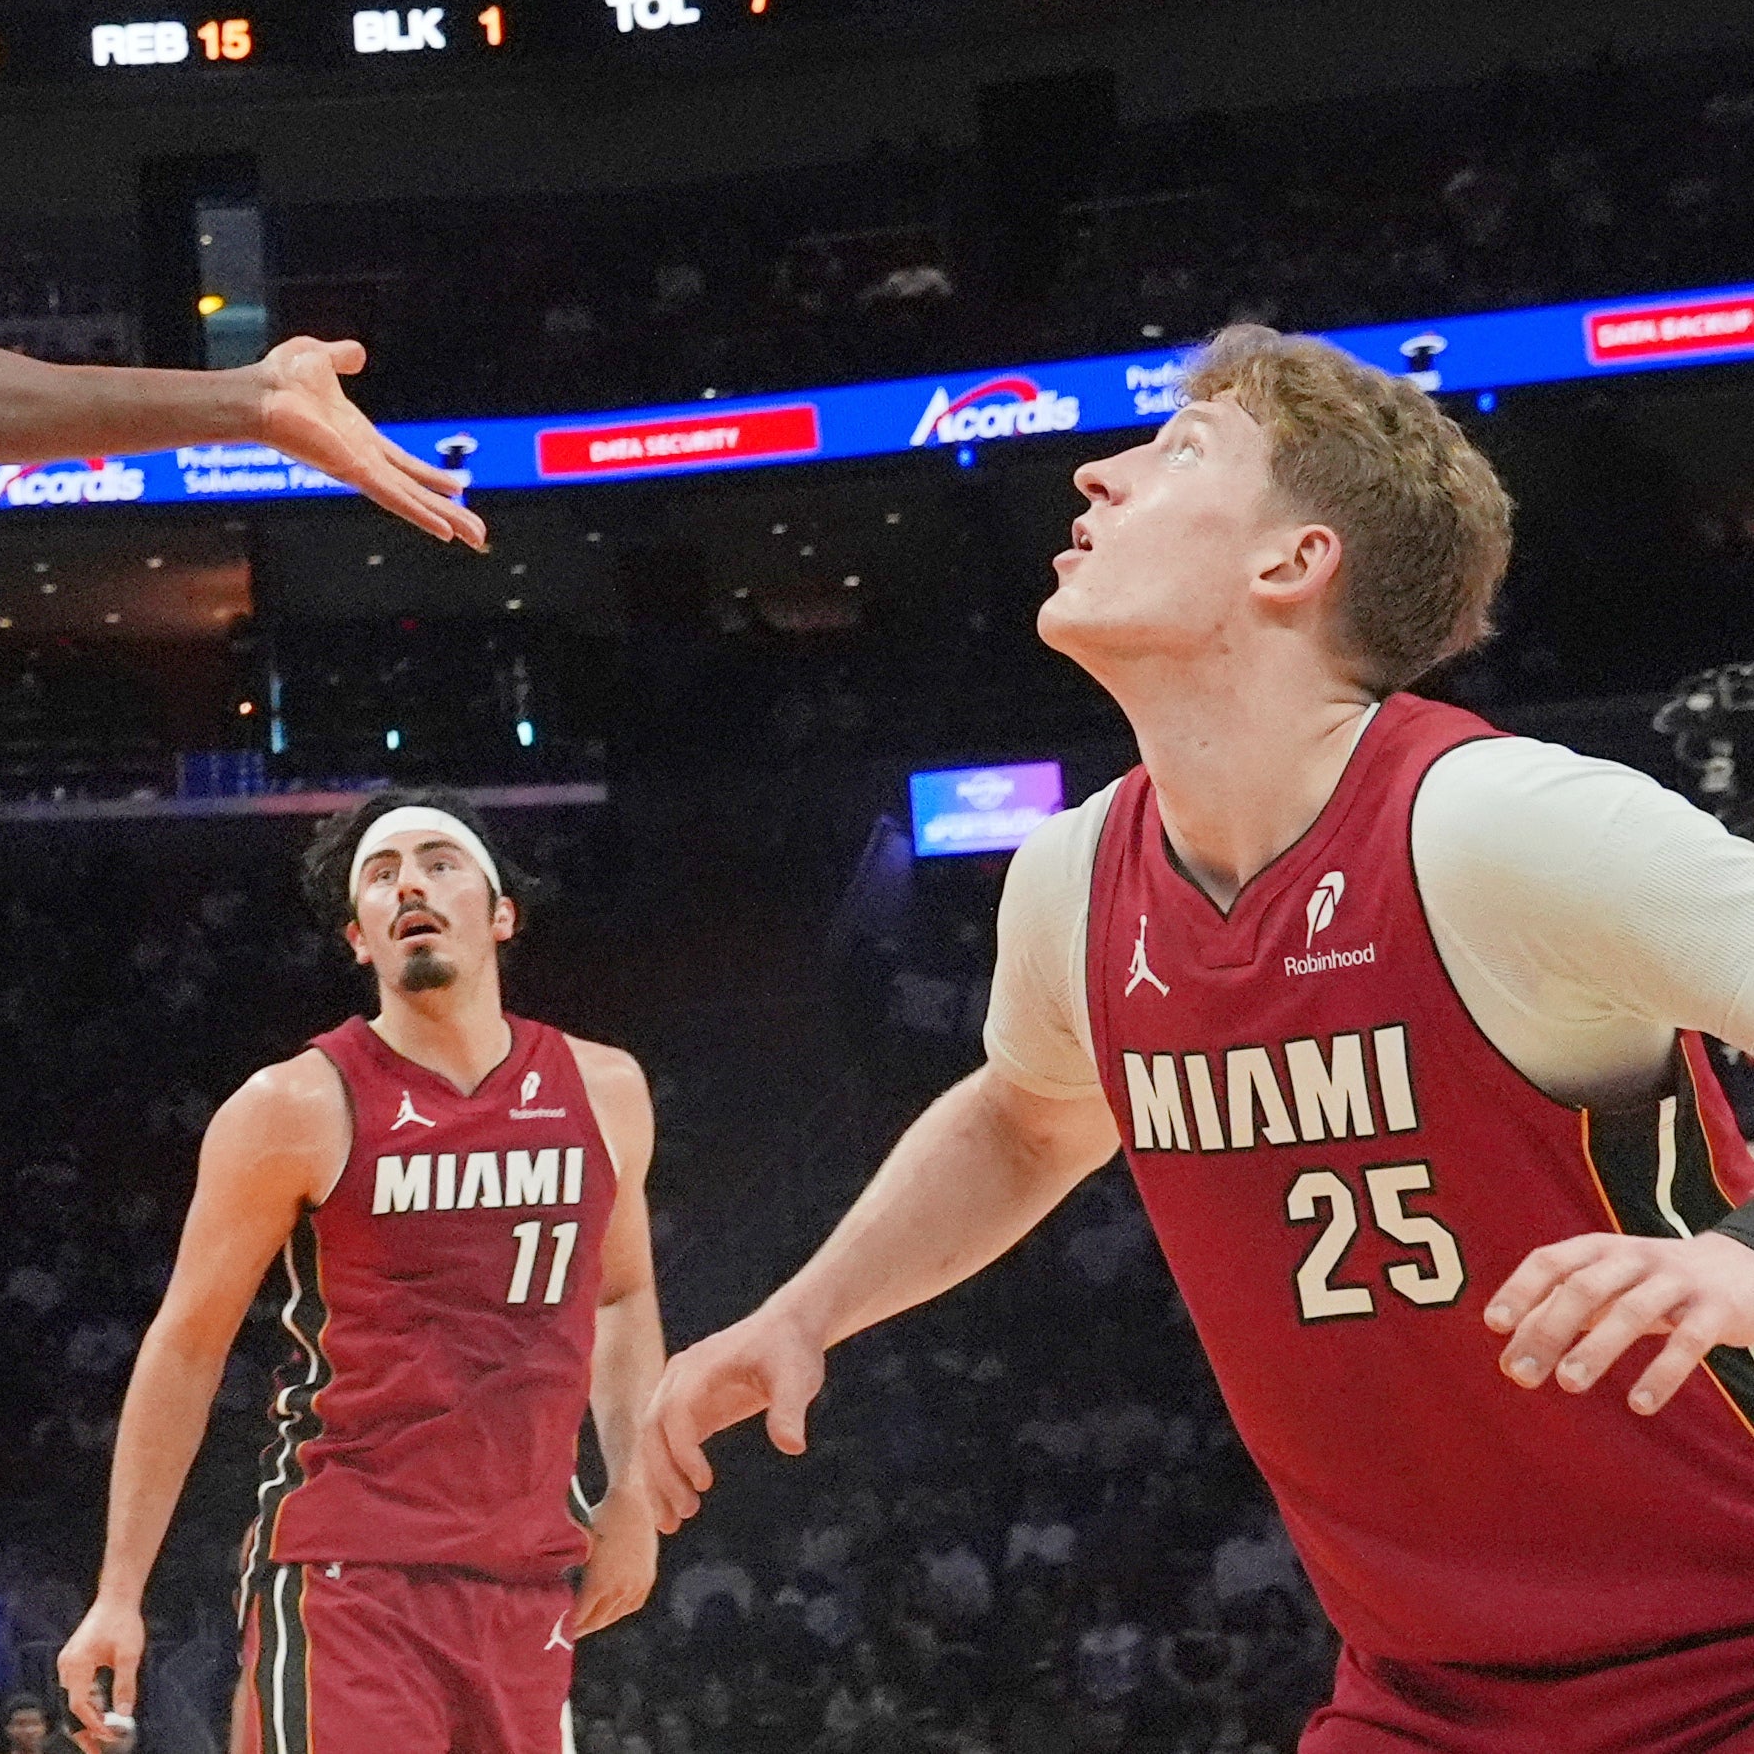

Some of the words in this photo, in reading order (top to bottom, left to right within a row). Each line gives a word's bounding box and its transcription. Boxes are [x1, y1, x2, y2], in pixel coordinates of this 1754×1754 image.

[92, 21, 189, 67] REB
[197, 18, 252, 61] 15
[353, 7, 446, 54] BLK
[478, 4, 505, 47] 1
[909, 386, 1080, 447] Acordis
[1282, 941, 1376, 978] Robinhood
[1122, 1023, 1417, 1153] MIAMI
[371, 1146, 585, 1216] MIAMI
[505, 1221, 579, 1305] 11
[1286, 1161, 1467, 1322] 25
